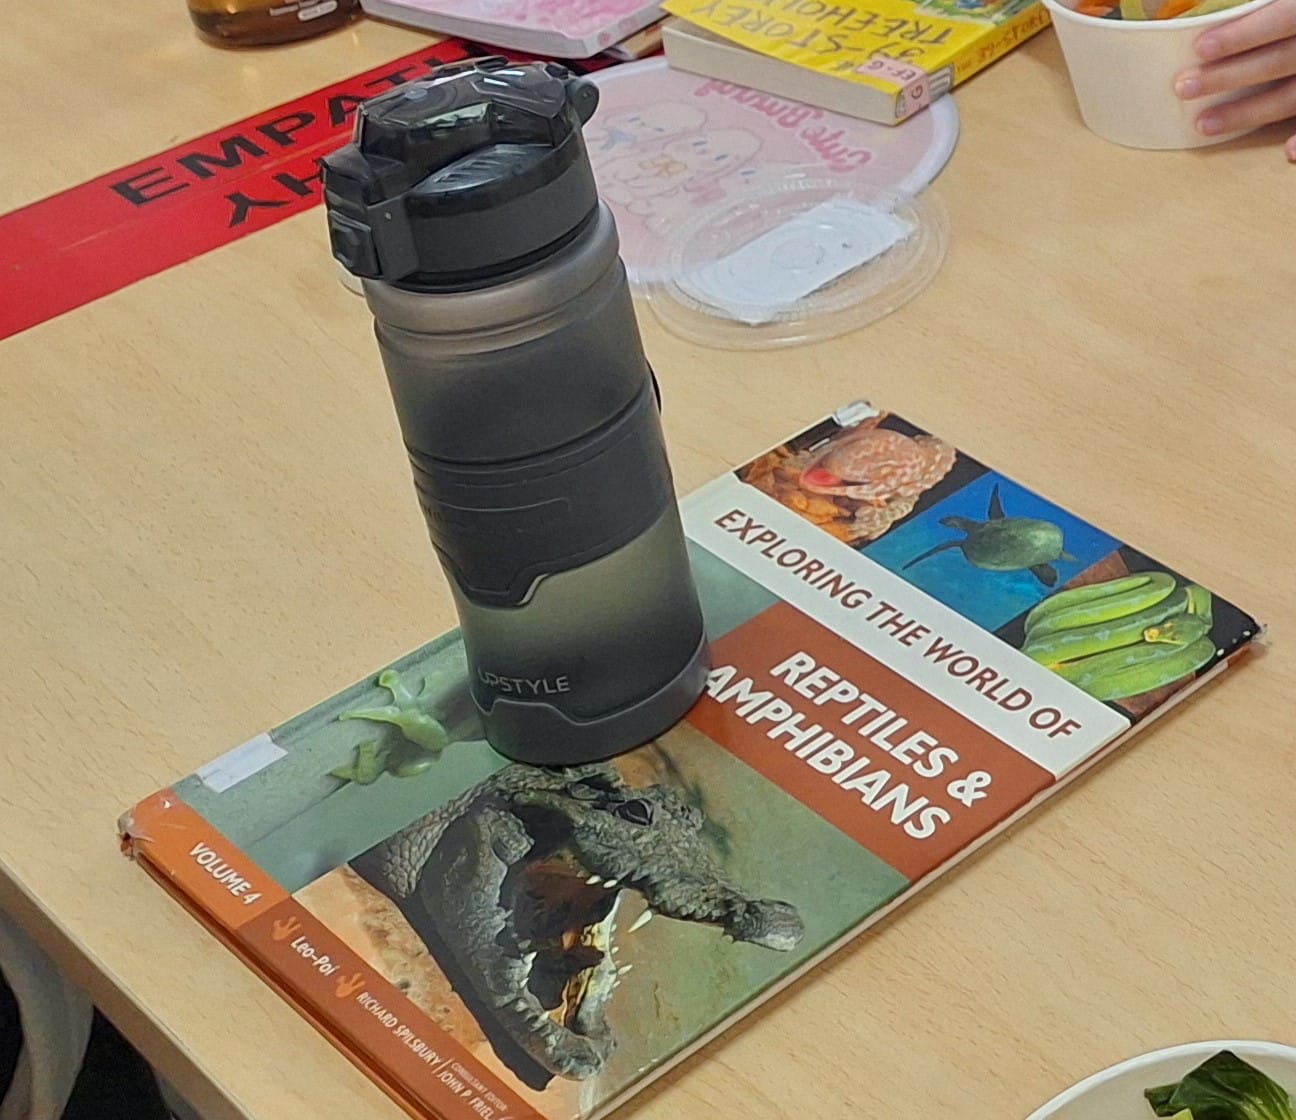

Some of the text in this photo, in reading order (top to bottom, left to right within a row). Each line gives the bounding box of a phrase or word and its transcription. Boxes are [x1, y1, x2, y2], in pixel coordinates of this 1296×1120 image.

[714, 508, 1082, 740] EXPLORING THE WORLD OF
[704, 664, 951, 840] AMPHIBIANS
[770, 650, 992, 808] REPTILES &
[188, 841, 264, 907] VOLUME 4
[355, 991, 442, 1067] RICHARD SPILSBURY
[436, 1070, 466, 1094] JOHN
[469, 1096, 495, 1120] FRIEL
